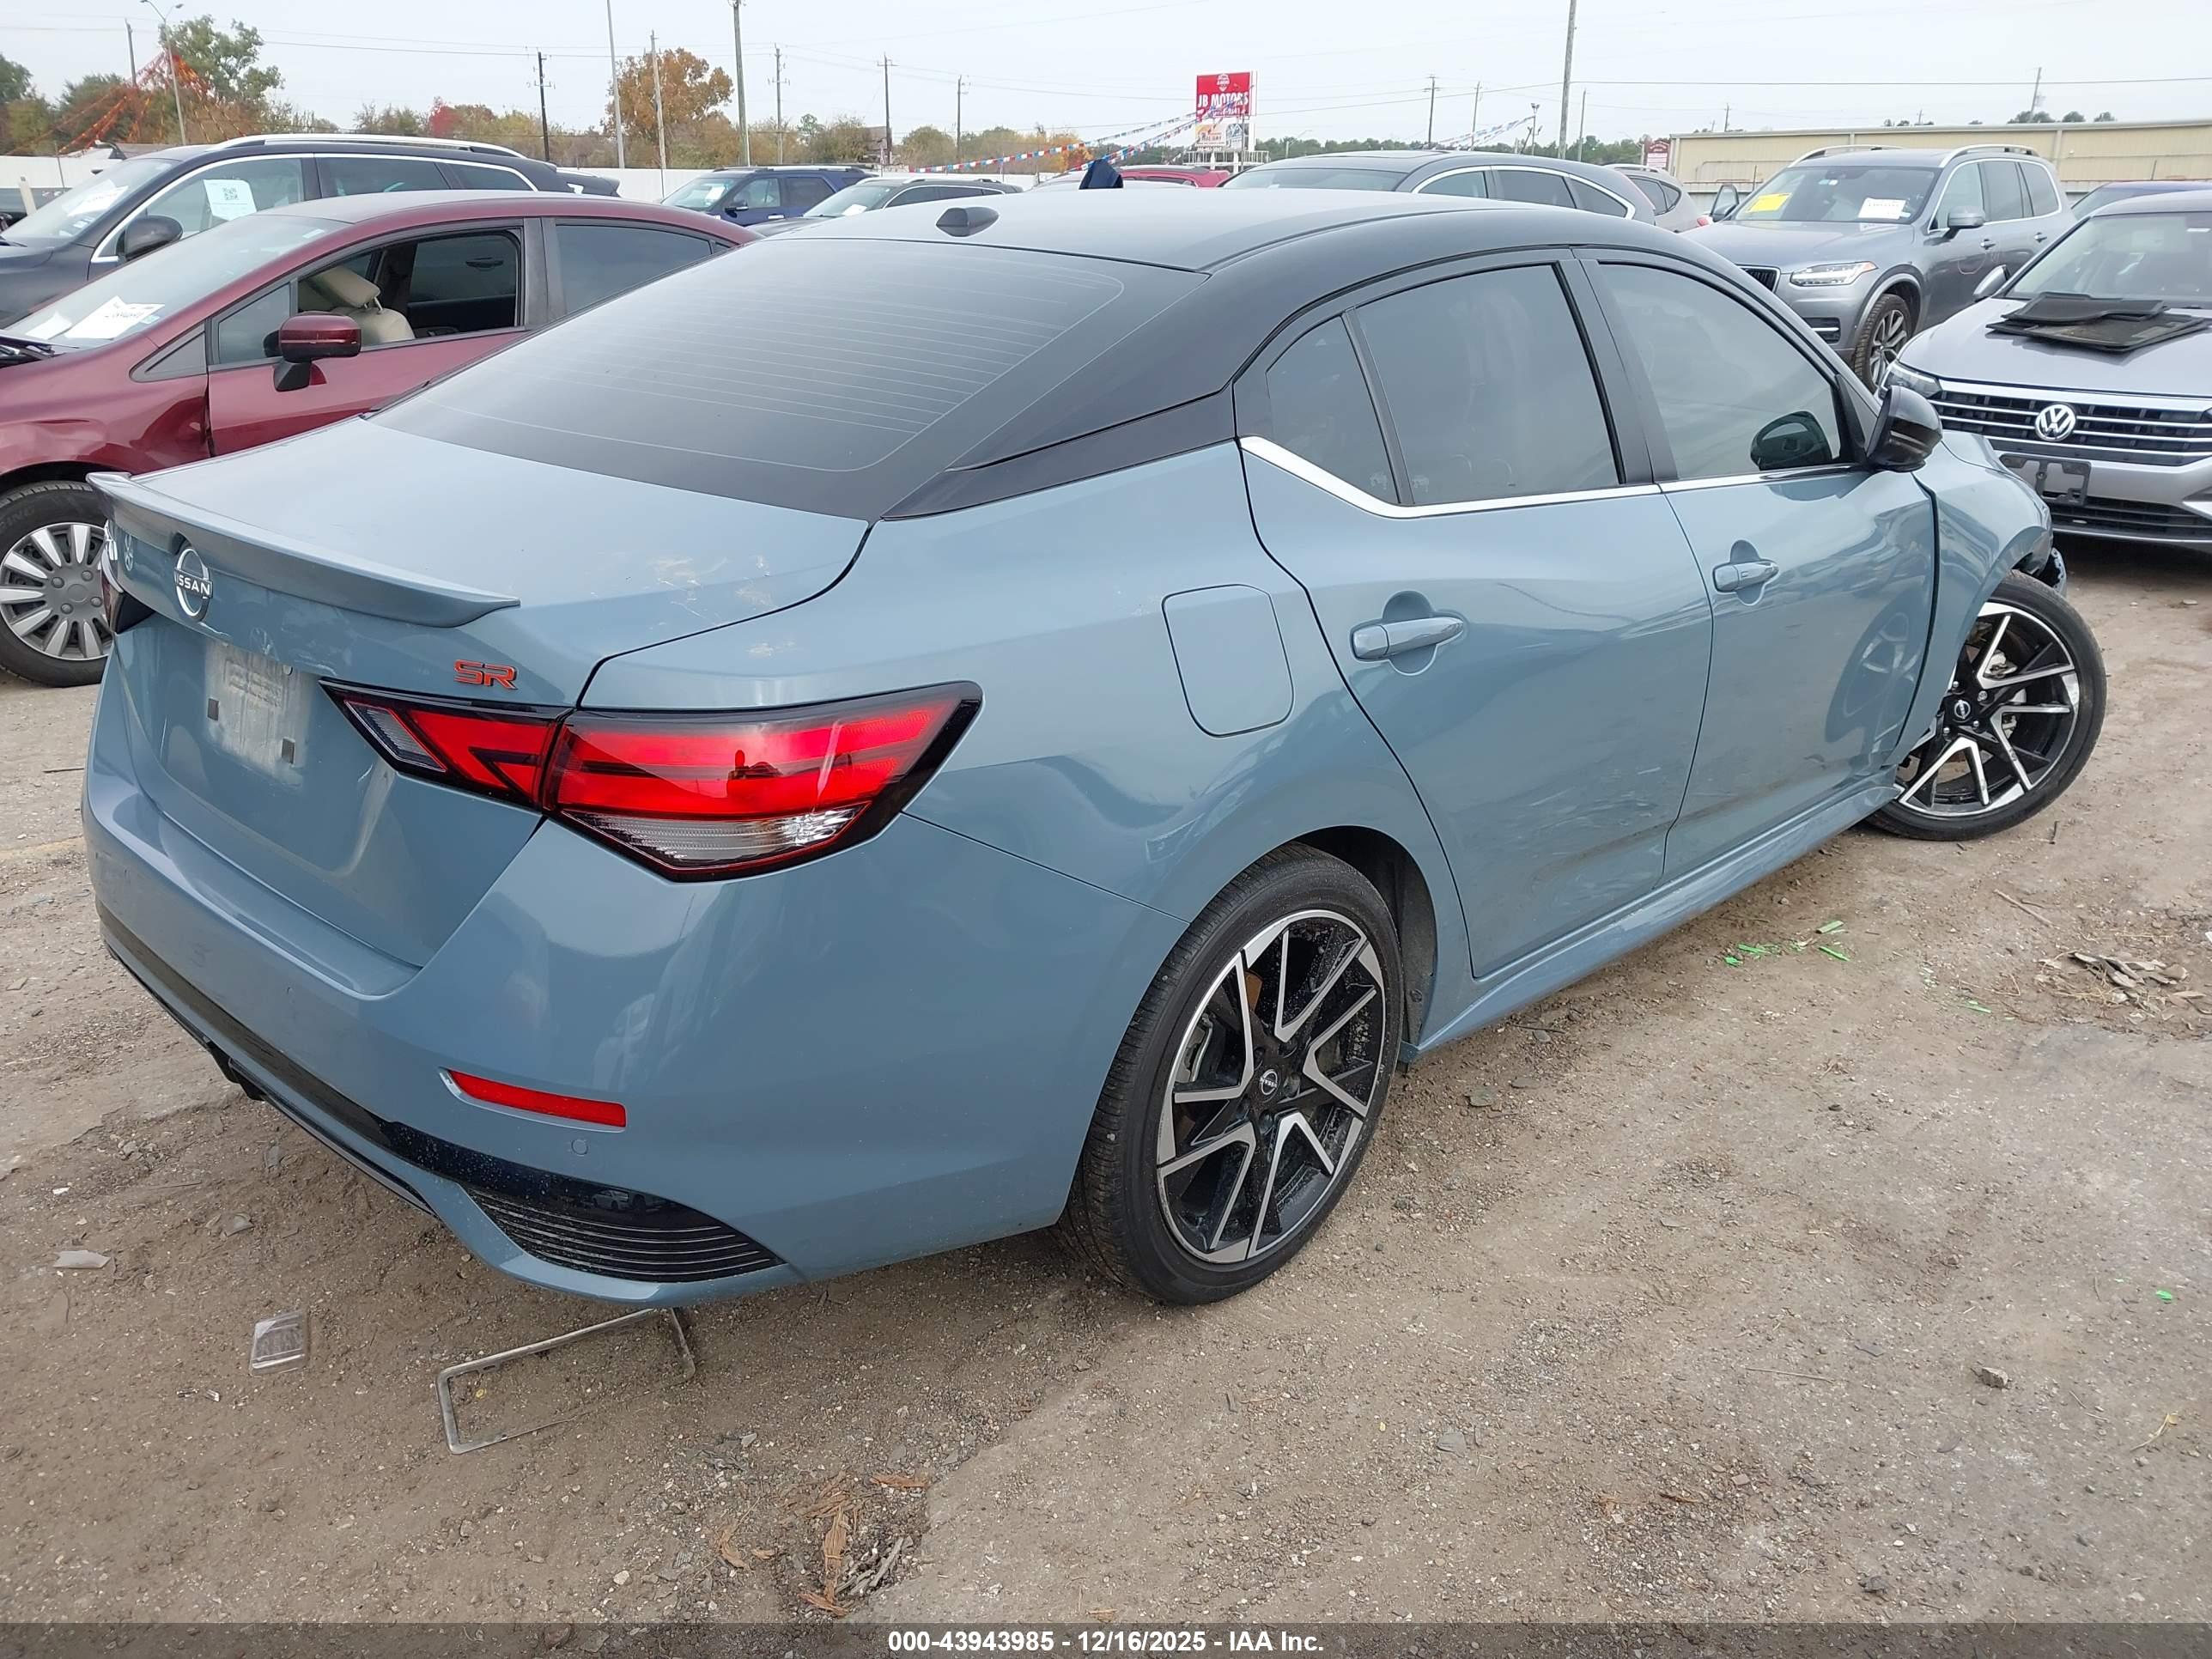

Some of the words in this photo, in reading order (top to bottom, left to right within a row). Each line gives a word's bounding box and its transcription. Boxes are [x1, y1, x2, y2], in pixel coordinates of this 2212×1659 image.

[1198, 94, 1209, 108] JB
[1211, 92, 1249, 108] MOTORS
[453, 659, 518, 690] SR
